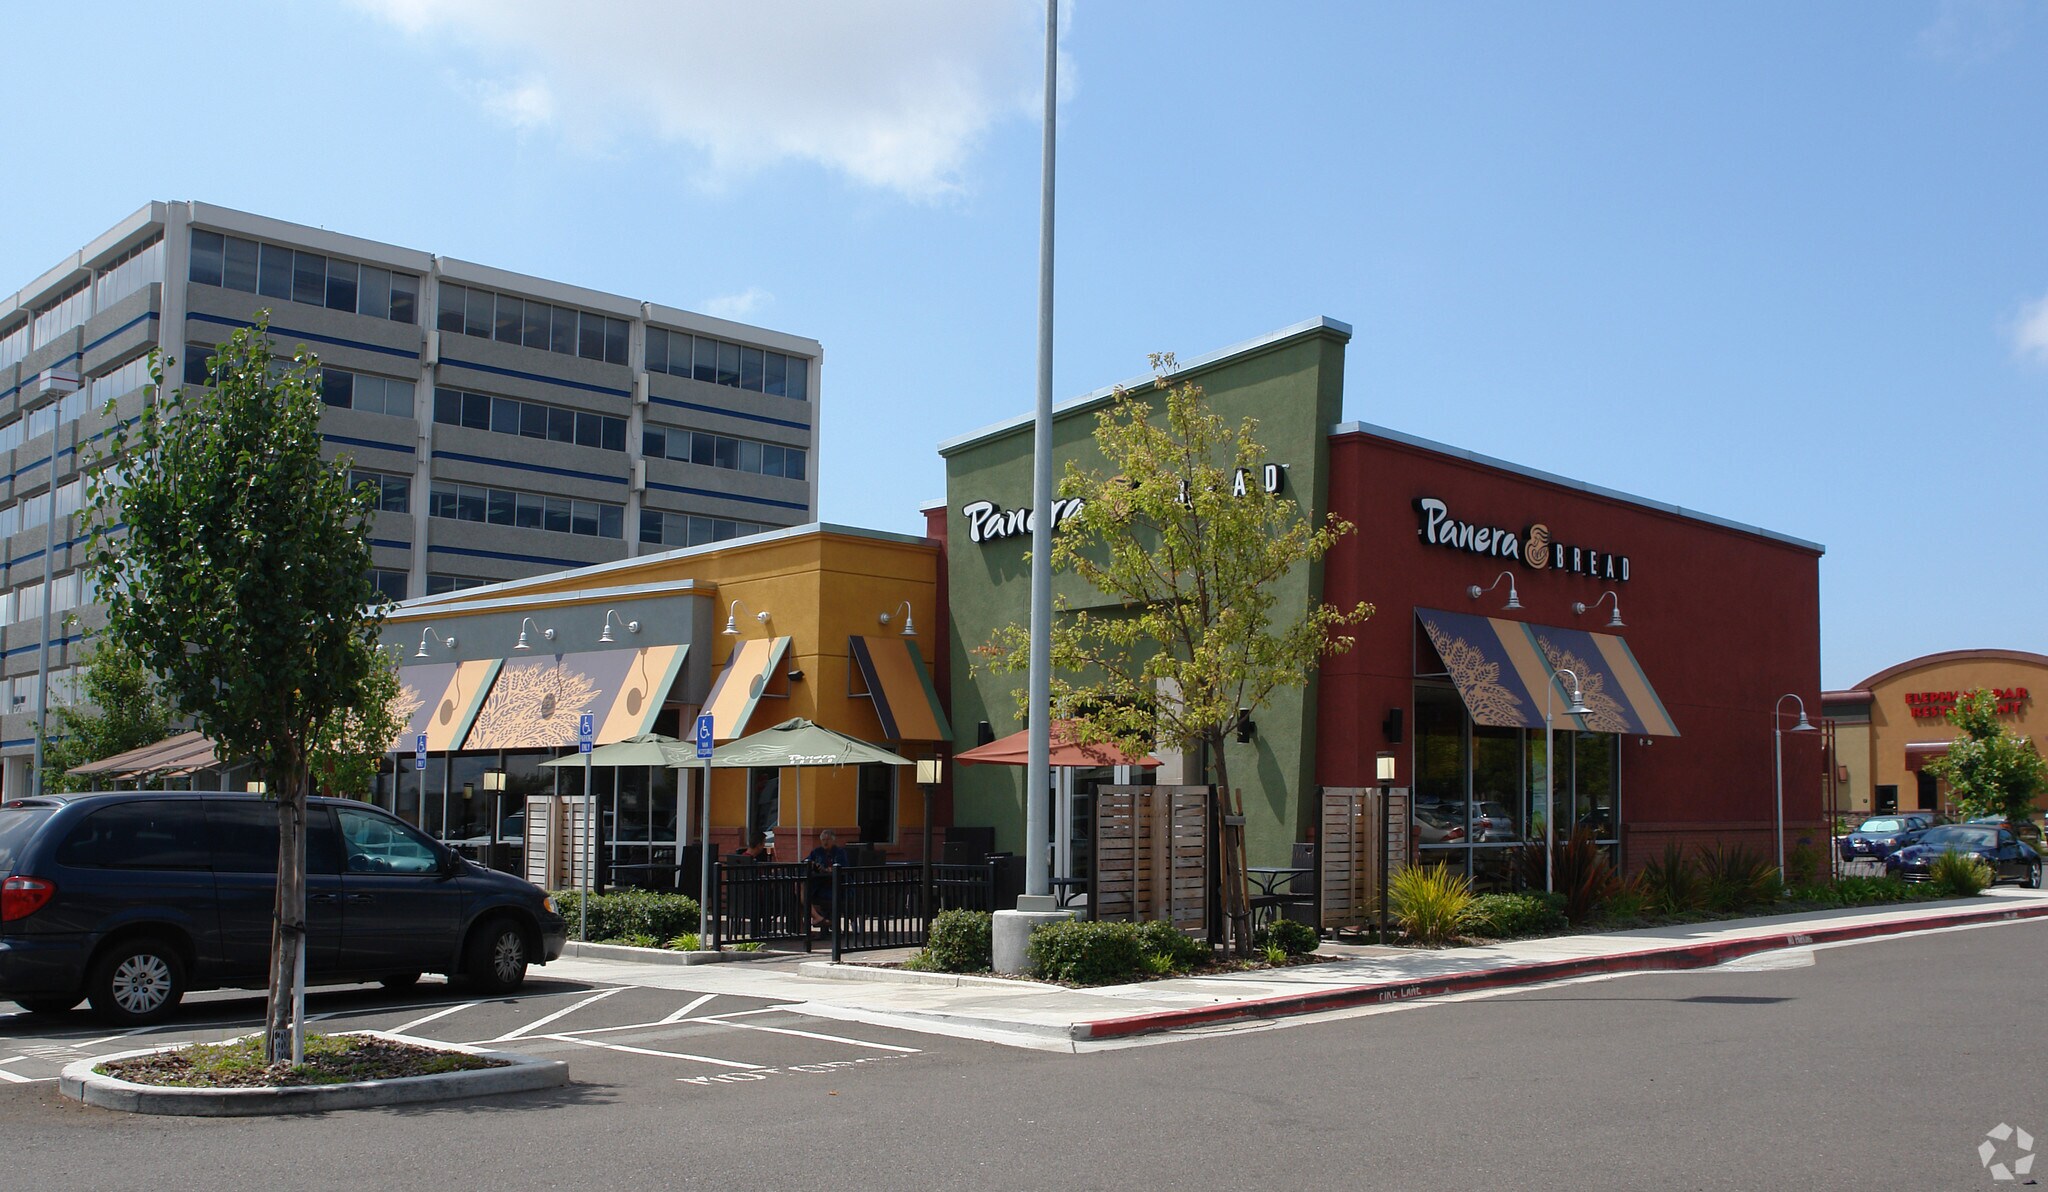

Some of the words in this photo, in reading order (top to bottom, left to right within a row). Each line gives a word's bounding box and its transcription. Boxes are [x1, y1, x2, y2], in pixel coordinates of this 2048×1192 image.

[963, 499, 1086, 542] Panra
[1421, 498, 1519, 560] Panera
[1556, 543, 1629, 581] BREAD
